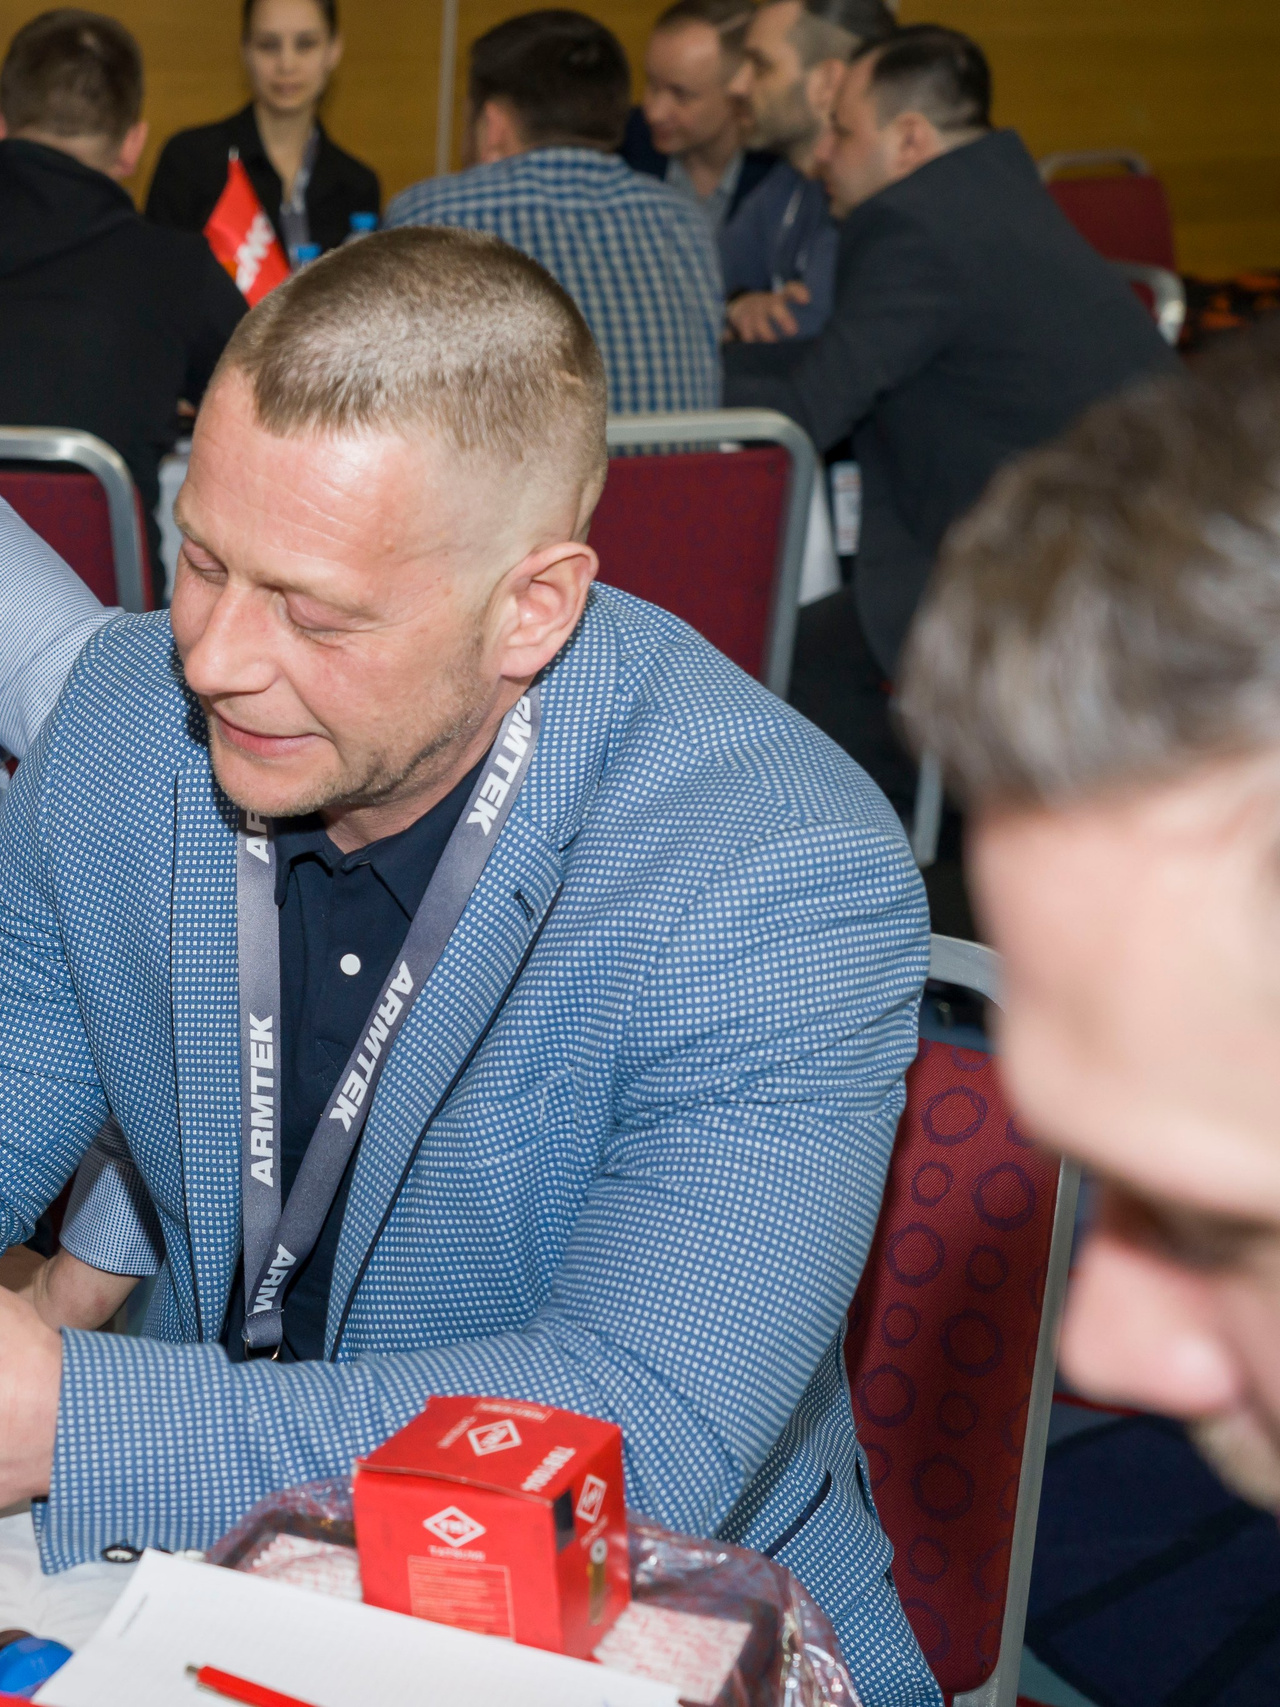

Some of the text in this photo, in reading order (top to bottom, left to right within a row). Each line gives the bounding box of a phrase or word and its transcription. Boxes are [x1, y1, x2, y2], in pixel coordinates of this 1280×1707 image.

[466, 695, 532, 836] RMTEK
[249, 1012, 274, 1187] ARMTEK
[329, 960, 414, 1132] ARMTEK
